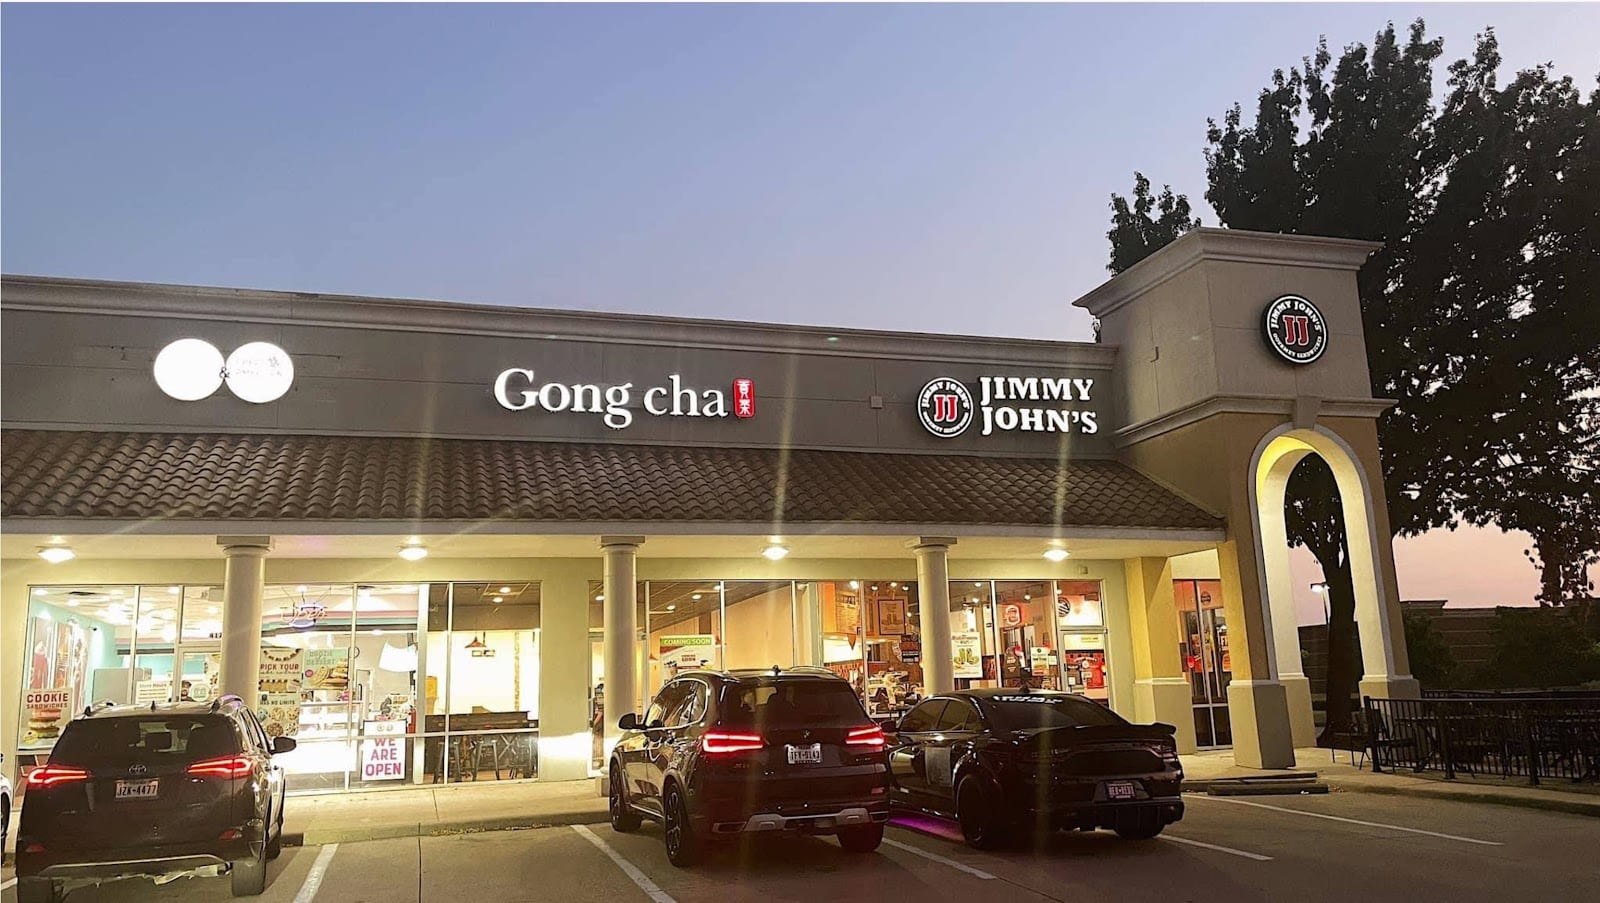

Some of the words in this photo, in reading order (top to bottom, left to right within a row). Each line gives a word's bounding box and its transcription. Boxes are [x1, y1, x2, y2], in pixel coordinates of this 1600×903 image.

[1271, 300, 1292, 330] JIMMY
[1293, 300, 1322, 333] JOHN'S
[1282, 314, 1309, 345] JJ
[493, 367, 633, 430] Gong
[643, 374, 729, 417] cha
[980, 376, 1094, 406] JIMMY
[933, 394, 959, 422] JJ
[981, 406, 1099, 436] JOHN'S
[260, 663, 277, 671] PICK
[280, 663, 299, 671] YOUR
[27, 693, 69, 703] COOKIE
[371, 748, 397, 760] ARE
[375, 737, 396, 747] WE
[365, 763, 402, 776] OPEN
